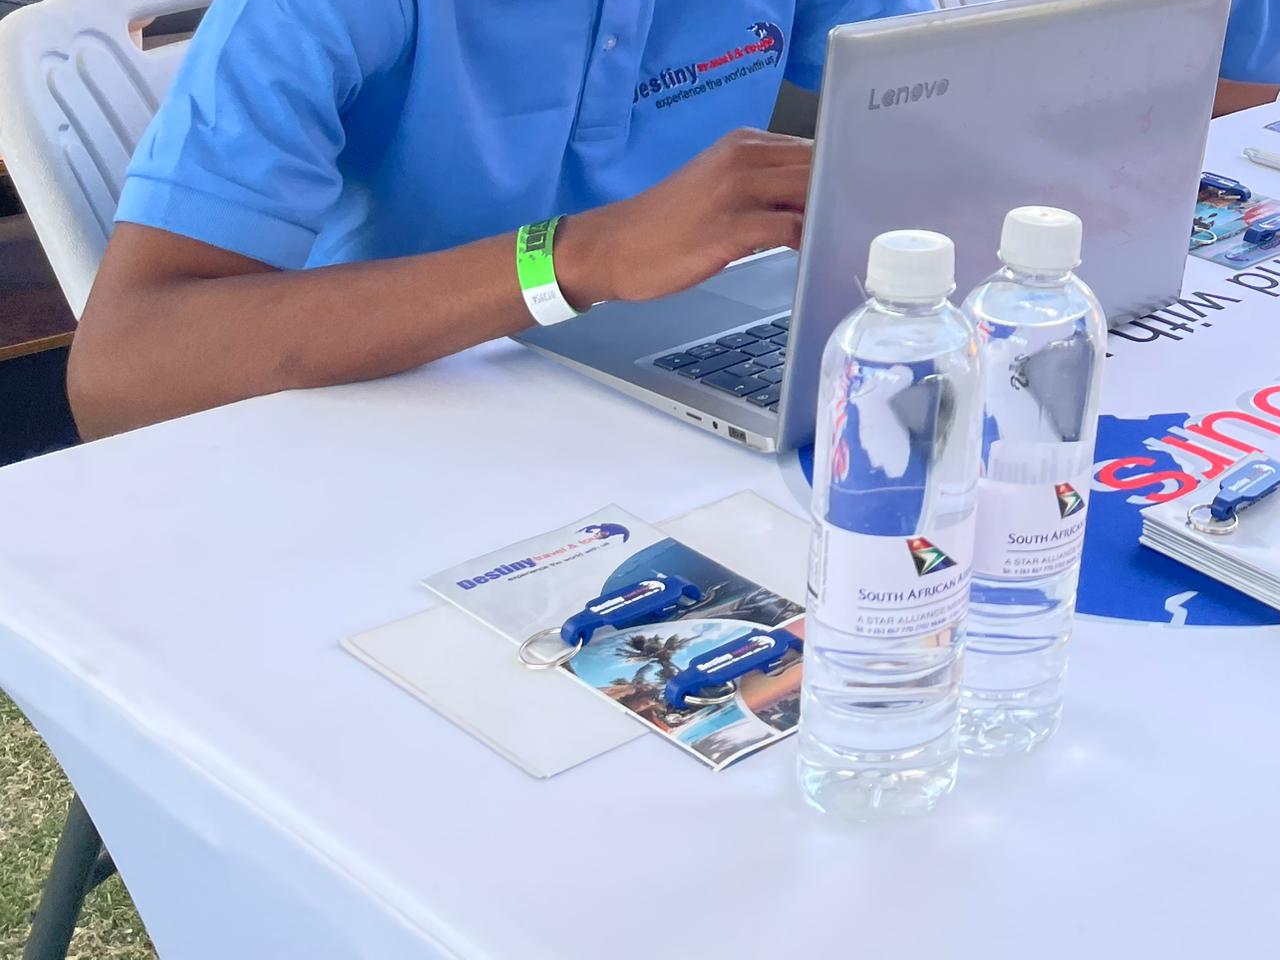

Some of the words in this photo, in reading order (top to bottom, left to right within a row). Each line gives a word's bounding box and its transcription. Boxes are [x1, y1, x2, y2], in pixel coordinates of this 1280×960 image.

[656, 82, 706, 109] experience
[706, 78, 723, 92] the
[724, 64, 749, 83] world
[868, 78, 949, 110] Lenovo
[1109, 290, 1243, 344] with
[456, 557, 536, 590] Destiny
[534, 547, 566, 562] travel
